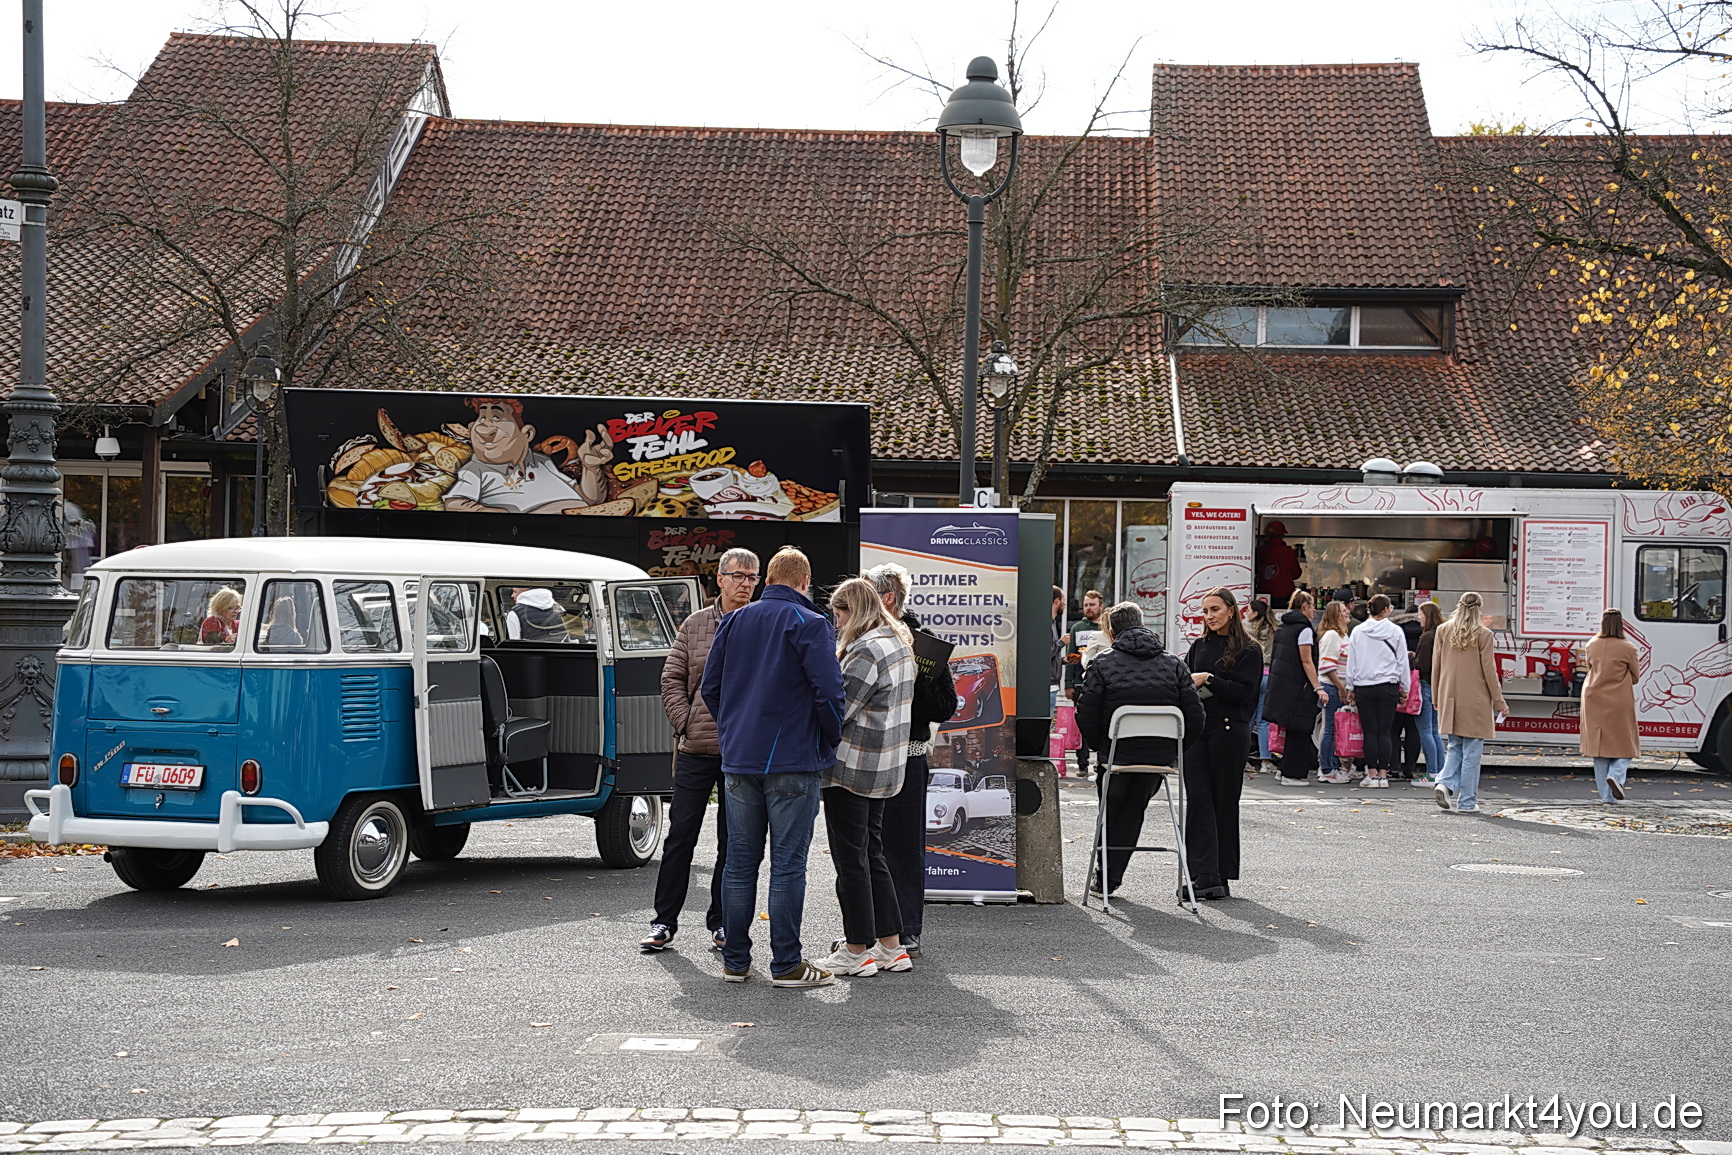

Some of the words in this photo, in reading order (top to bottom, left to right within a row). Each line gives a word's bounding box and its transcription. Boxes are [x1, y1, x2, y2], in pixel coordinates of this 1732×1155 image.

[624, 411, 656, 425] DER
[612, 446, 737, 482] STREETFOOD
[977, 490, 988, 508] C
[910, 574, 979, 587] LDTIMER
[916, 614, 1003, 627] HOOTINGS
[937, 634, 995, 647] VENTS!
[1524, 721, 1580, 730] POTATOES-I
[1638, 725, 1698, 734] ONADE-BEER
[161, 767, 196, 784] 0609
